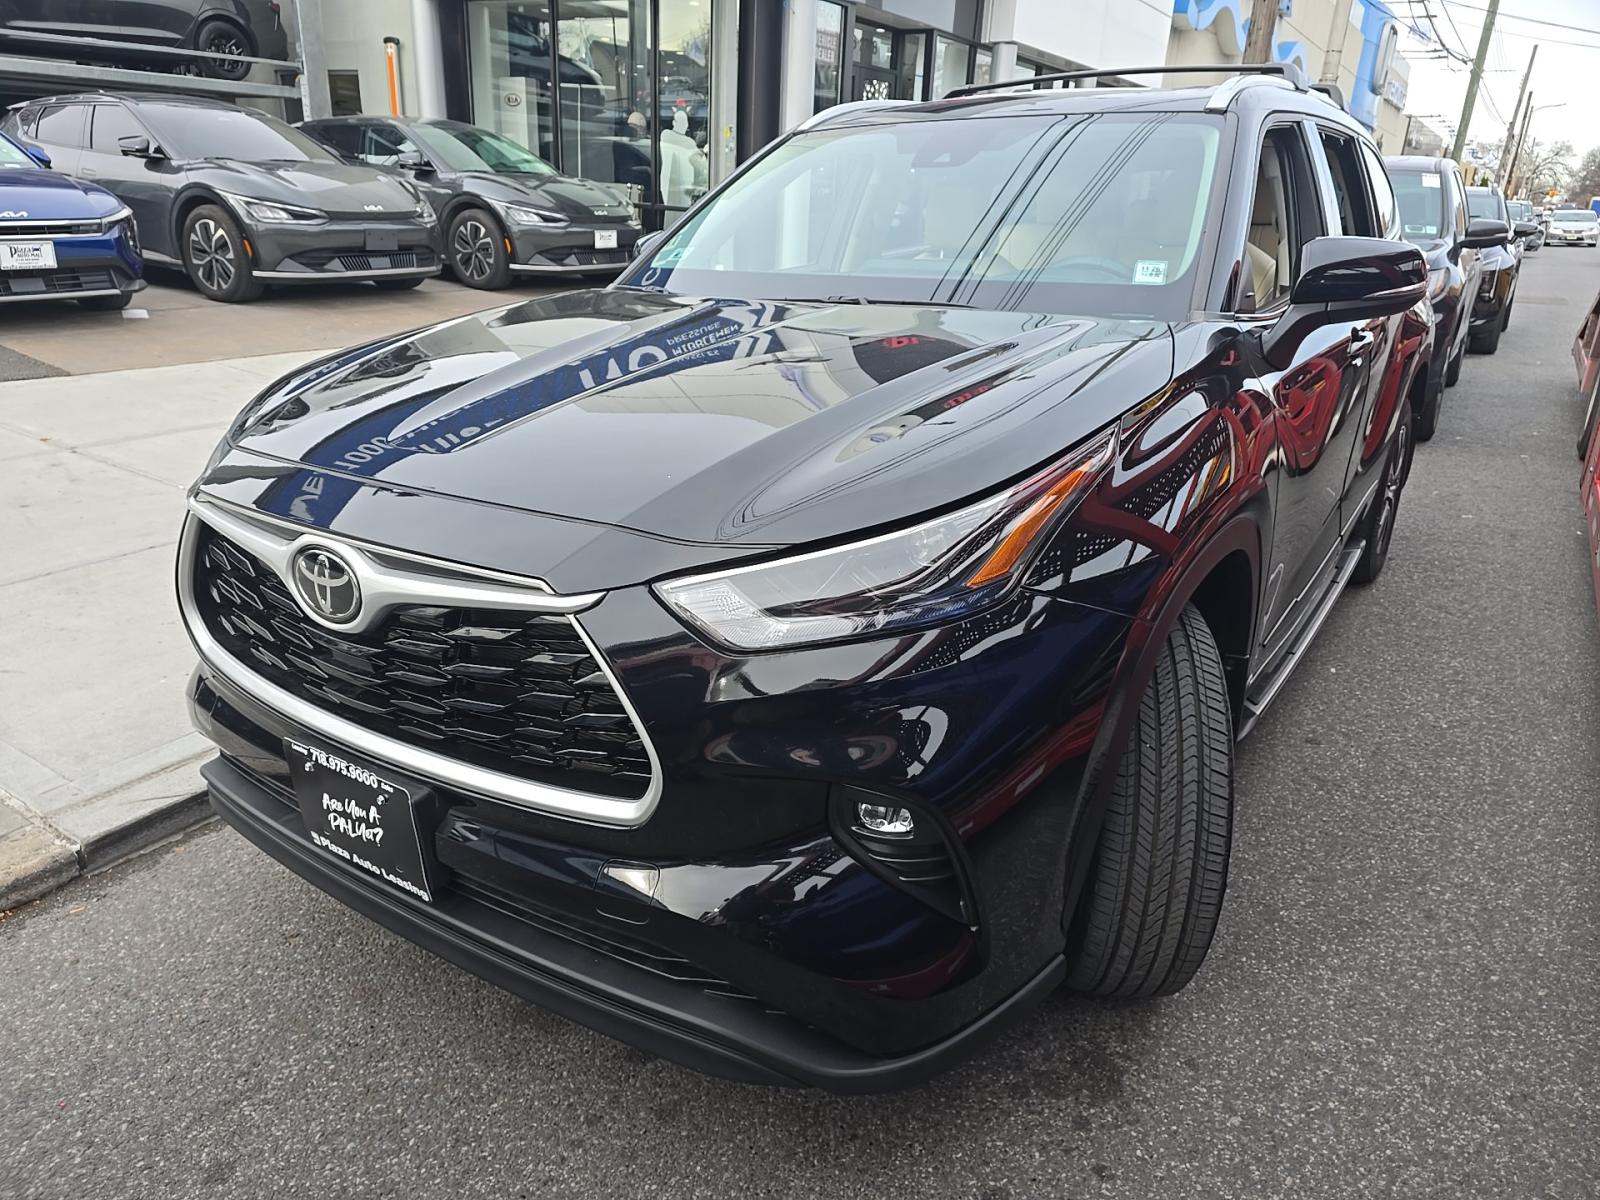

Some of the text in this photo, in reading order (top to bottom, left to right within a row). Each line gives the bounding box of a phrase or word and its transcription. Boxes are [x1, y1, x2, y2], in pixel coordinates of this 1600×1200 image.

[309, 748, 378, 789] 718.975.9000
[369, 805, 382, 826] A
[352, 853, 381, 875] Auto
[381, 868, 430, 902] Leasing
